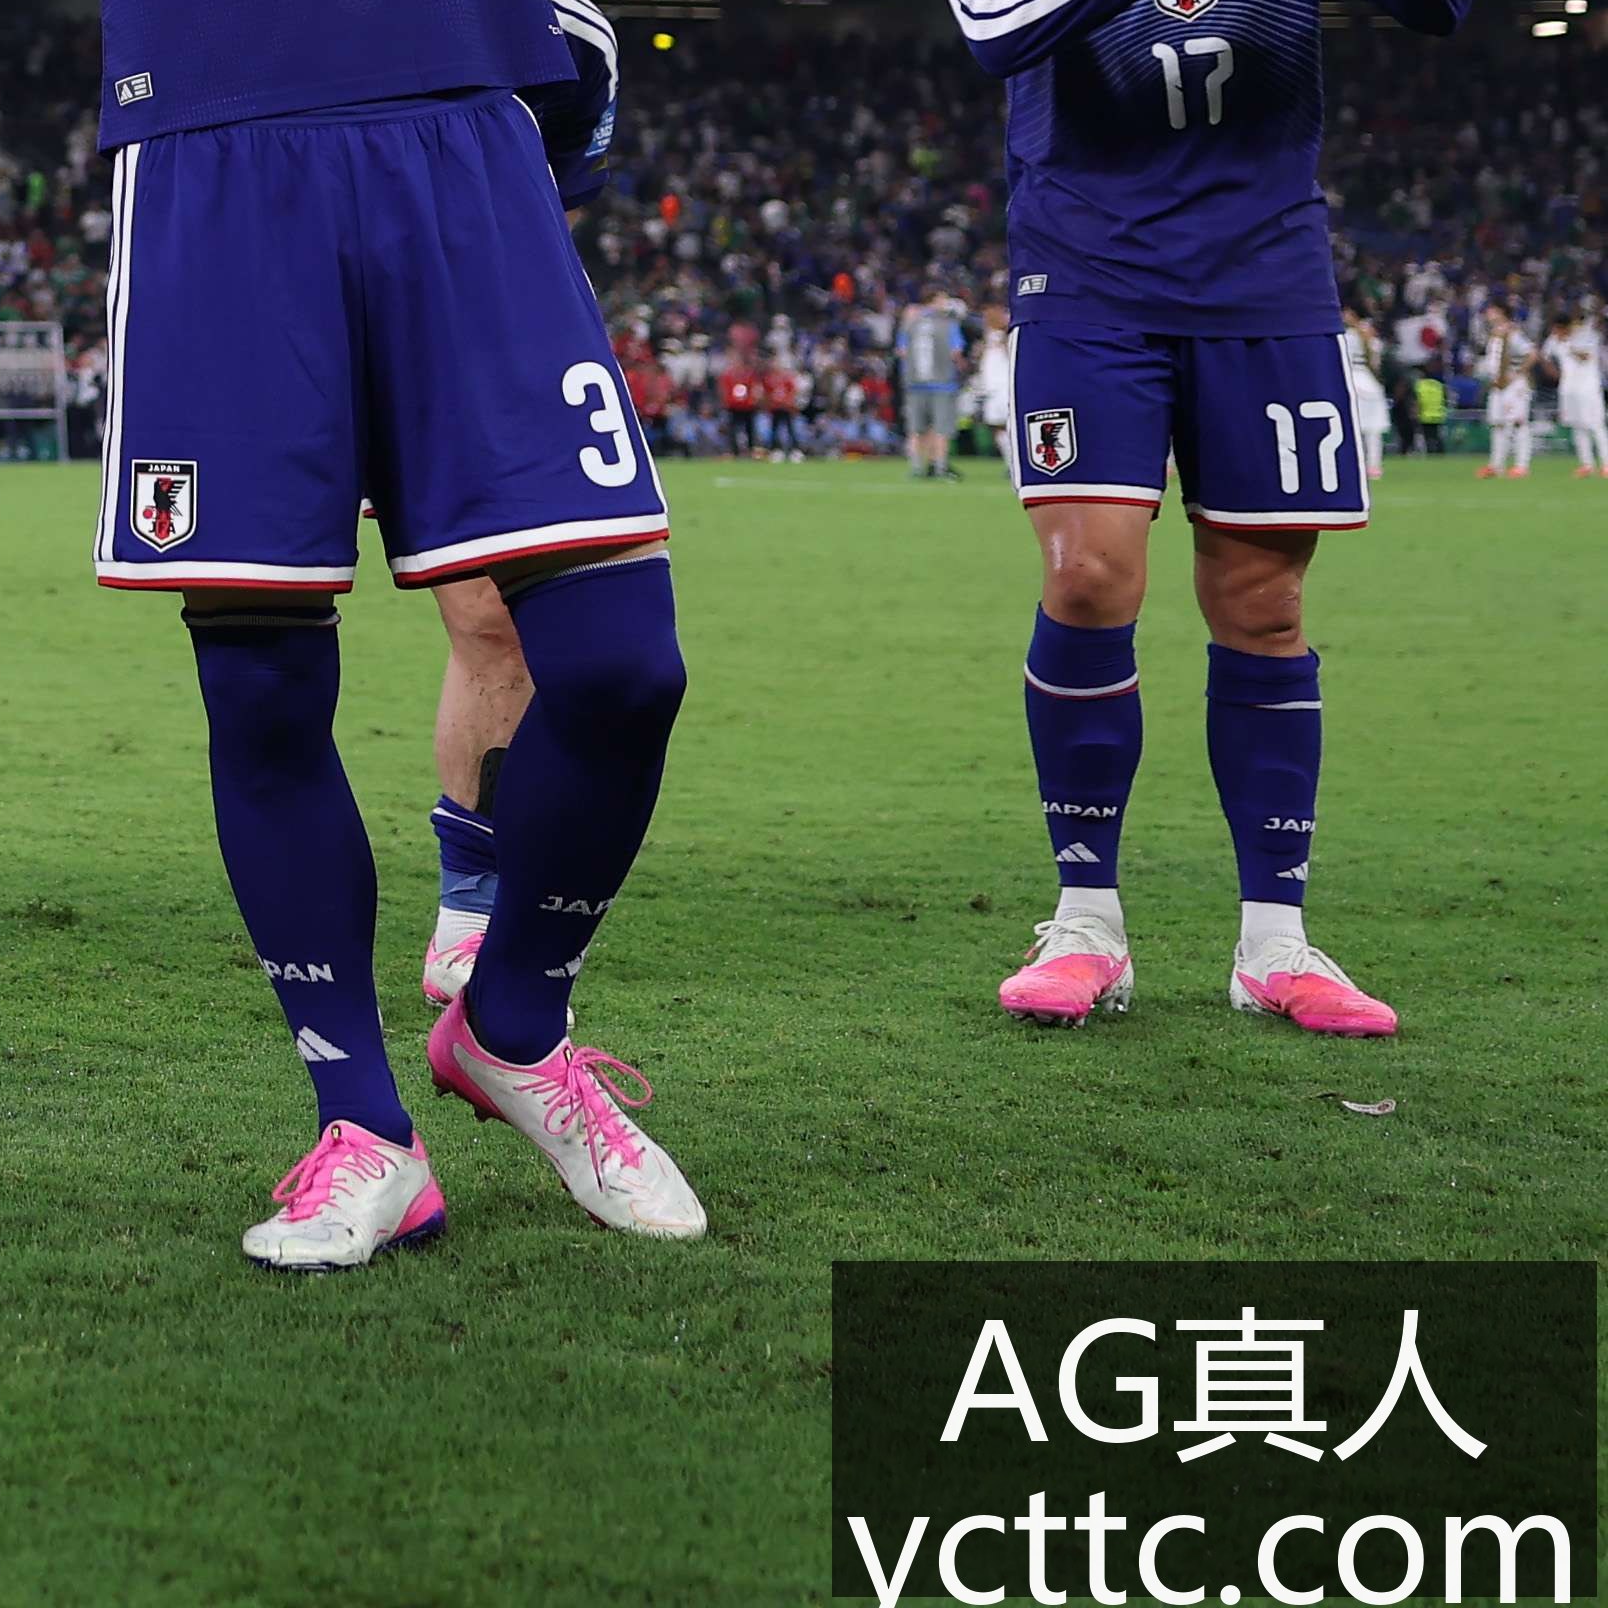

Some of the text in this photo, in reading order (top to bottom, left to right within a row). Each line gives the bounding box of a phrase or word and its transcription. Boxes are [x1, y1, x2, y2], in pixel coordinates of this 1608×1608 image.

[1152, 36, 1234, 130] 17
[148, 464, 180, 473] JAPAN
[561, 361, 637, 487] 3
[1265, 400, 1344, 494] 17
[262, 956, 334, 983] PAN
